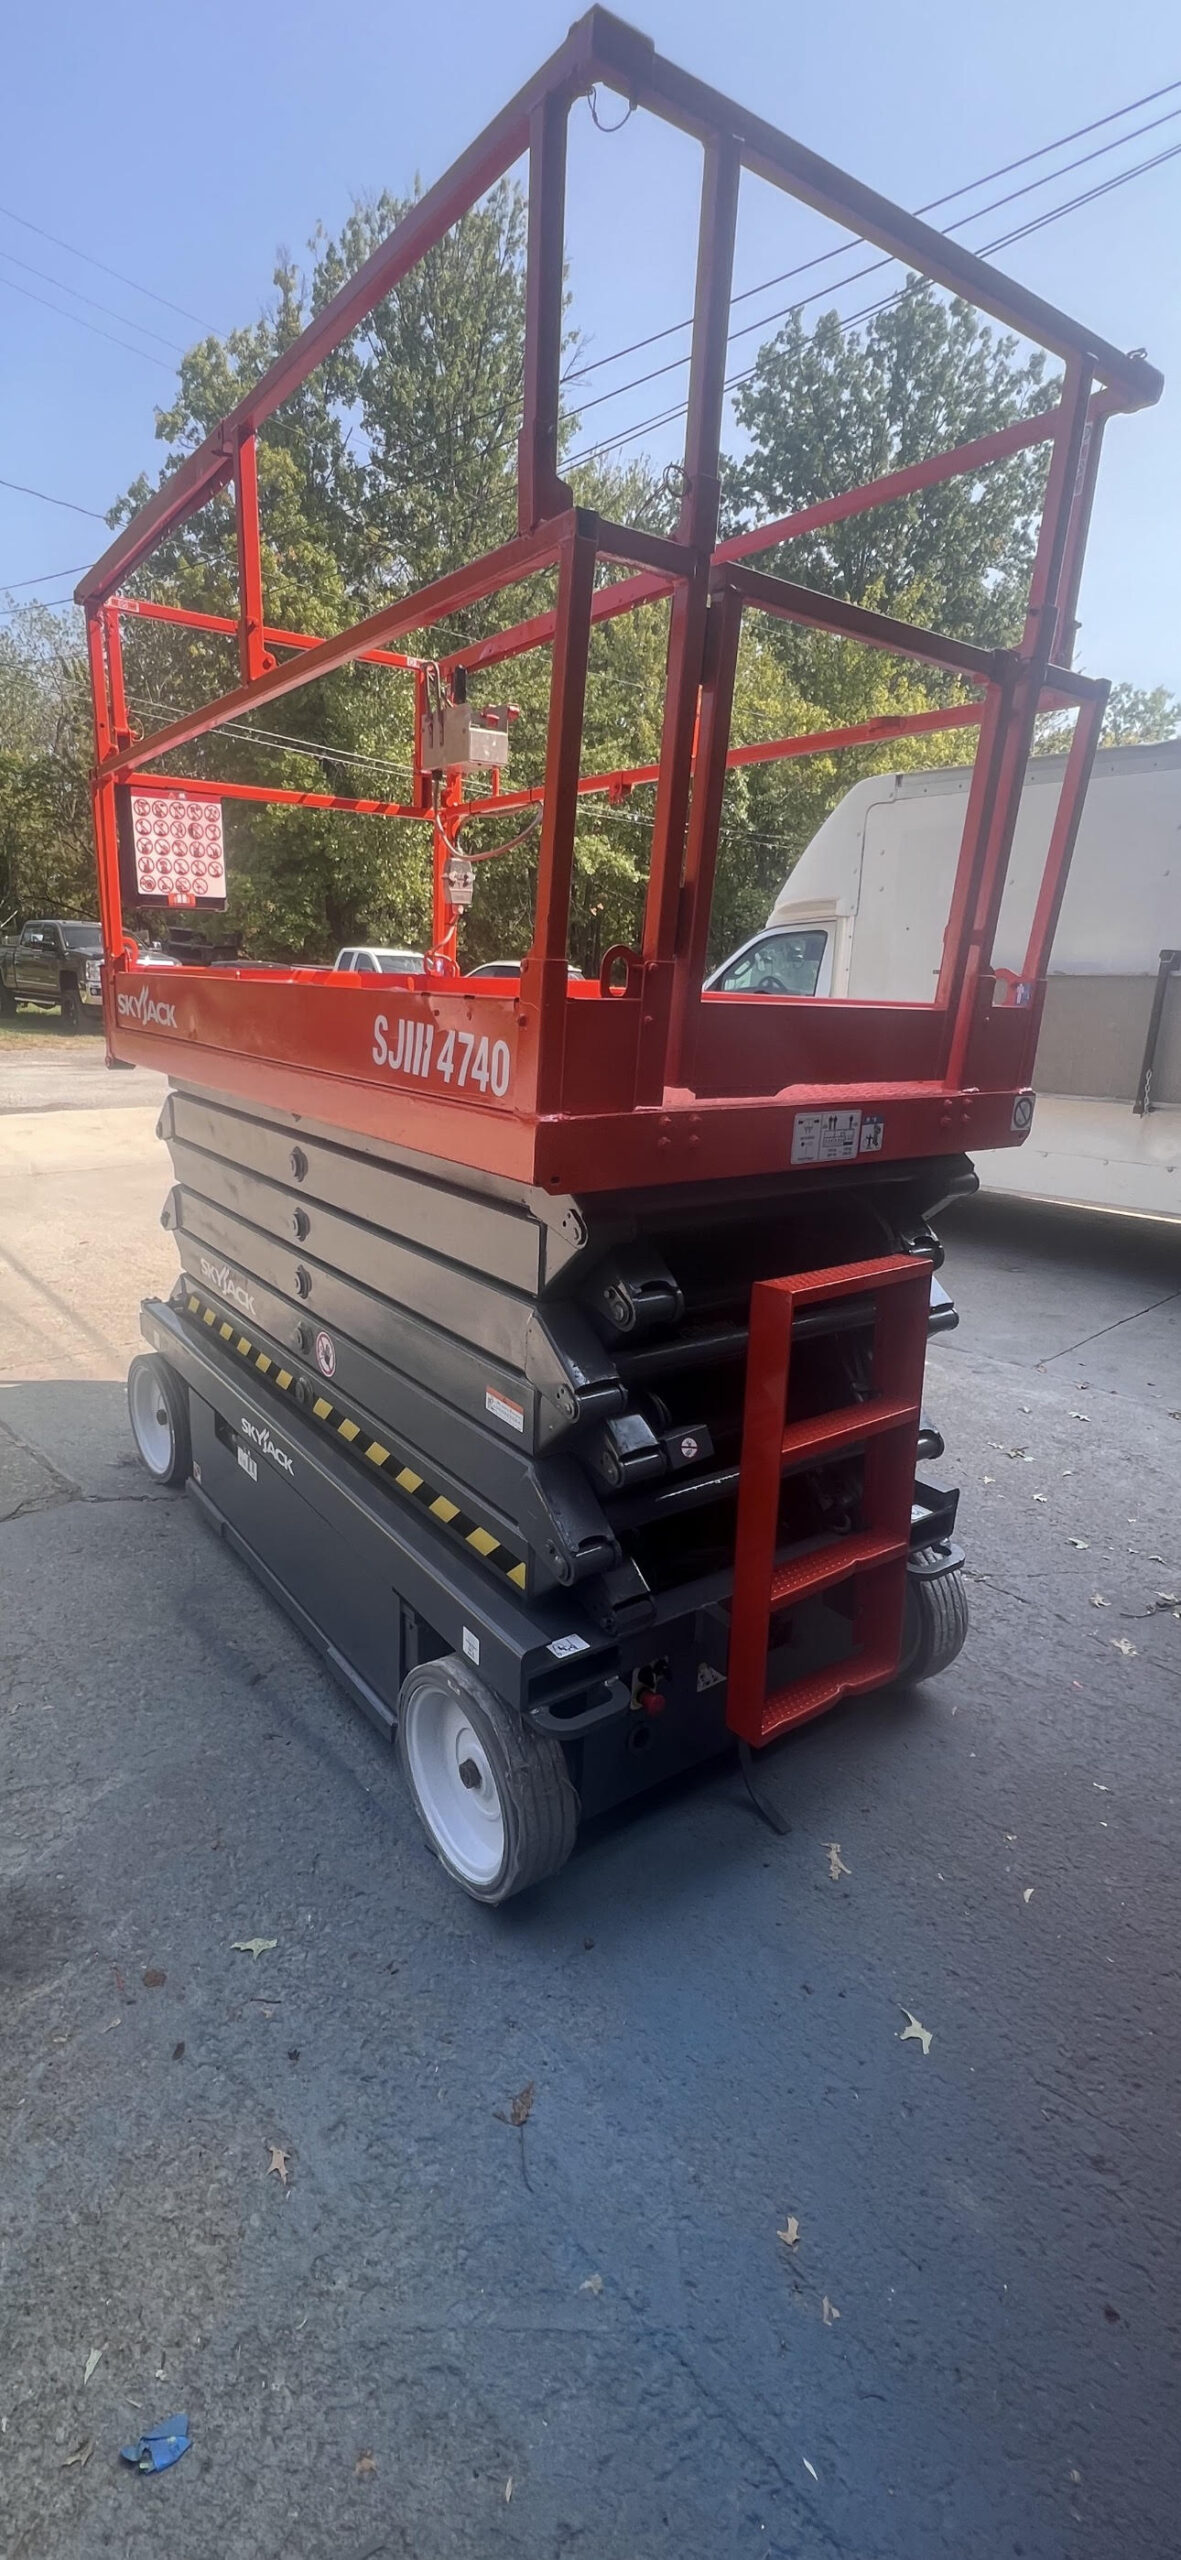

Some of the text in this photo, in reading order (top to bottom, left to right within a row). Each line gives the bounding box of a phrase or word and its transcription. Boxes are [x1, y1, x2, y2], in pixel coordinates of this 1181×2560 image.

[117, 984, 178, 1029] SKYJACK
[436, 1029, 510, 1097] 4740
[200, 1257, 257, 1316] SKYJACK
[240, 1417, 295, 1477] SKYJACK
